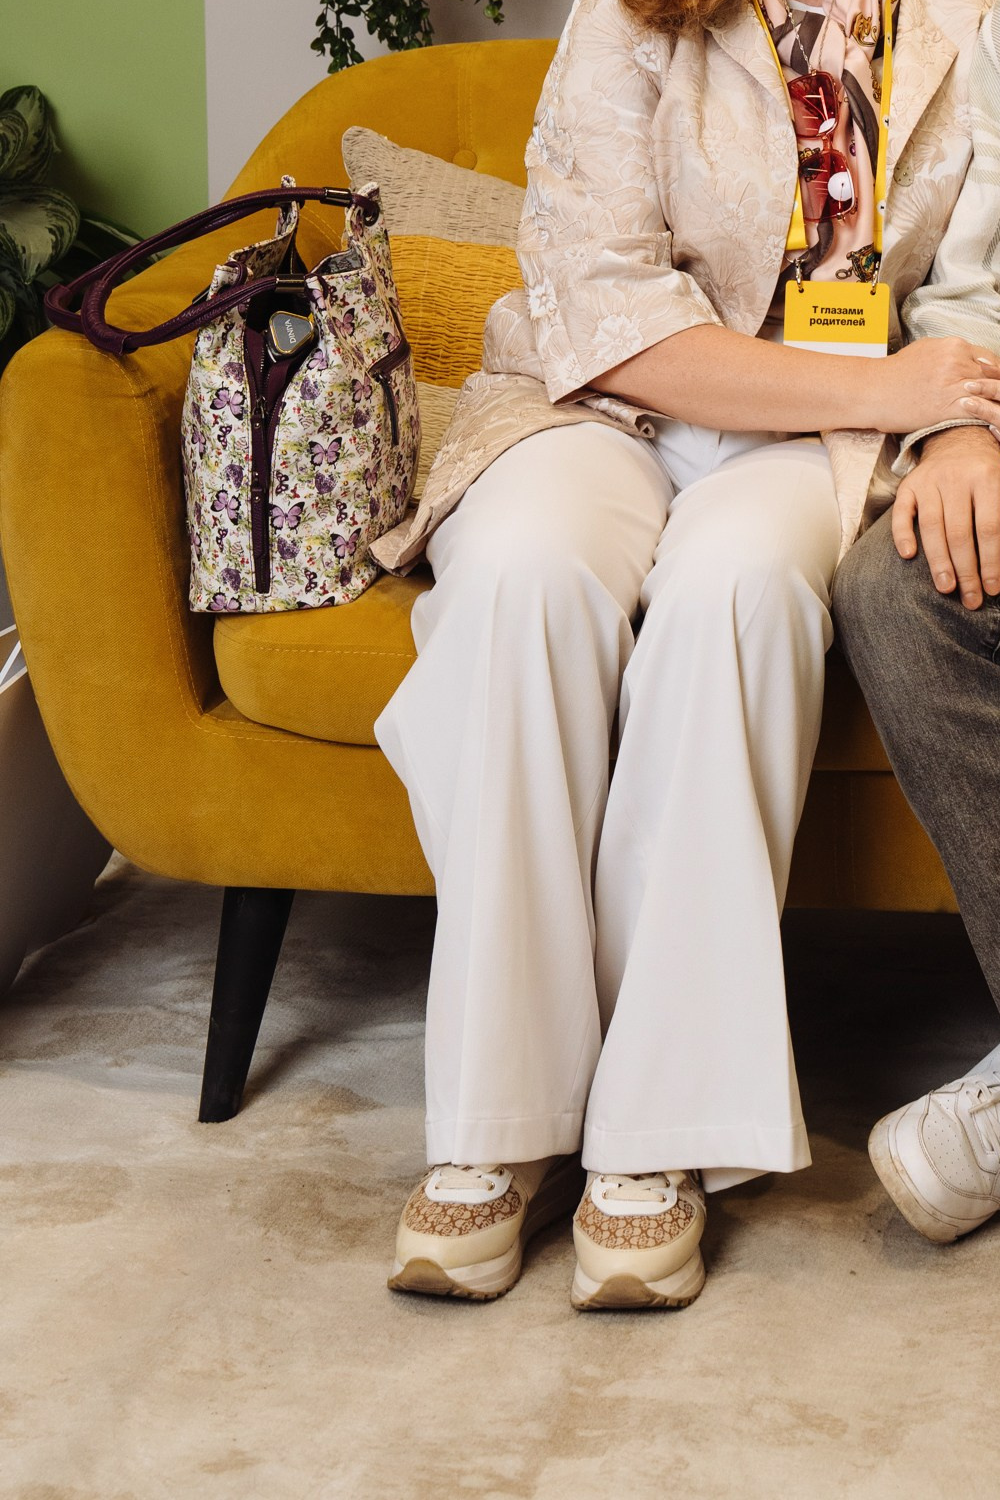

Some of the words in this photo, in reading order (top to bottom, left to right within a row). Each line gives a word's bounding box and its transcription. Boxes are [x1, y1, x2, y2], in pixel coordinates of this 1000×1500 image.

[812, 305, 819, 314] Т
[820, 307, 864, 315] глазами
[809, 317, 866, 327] родителей
